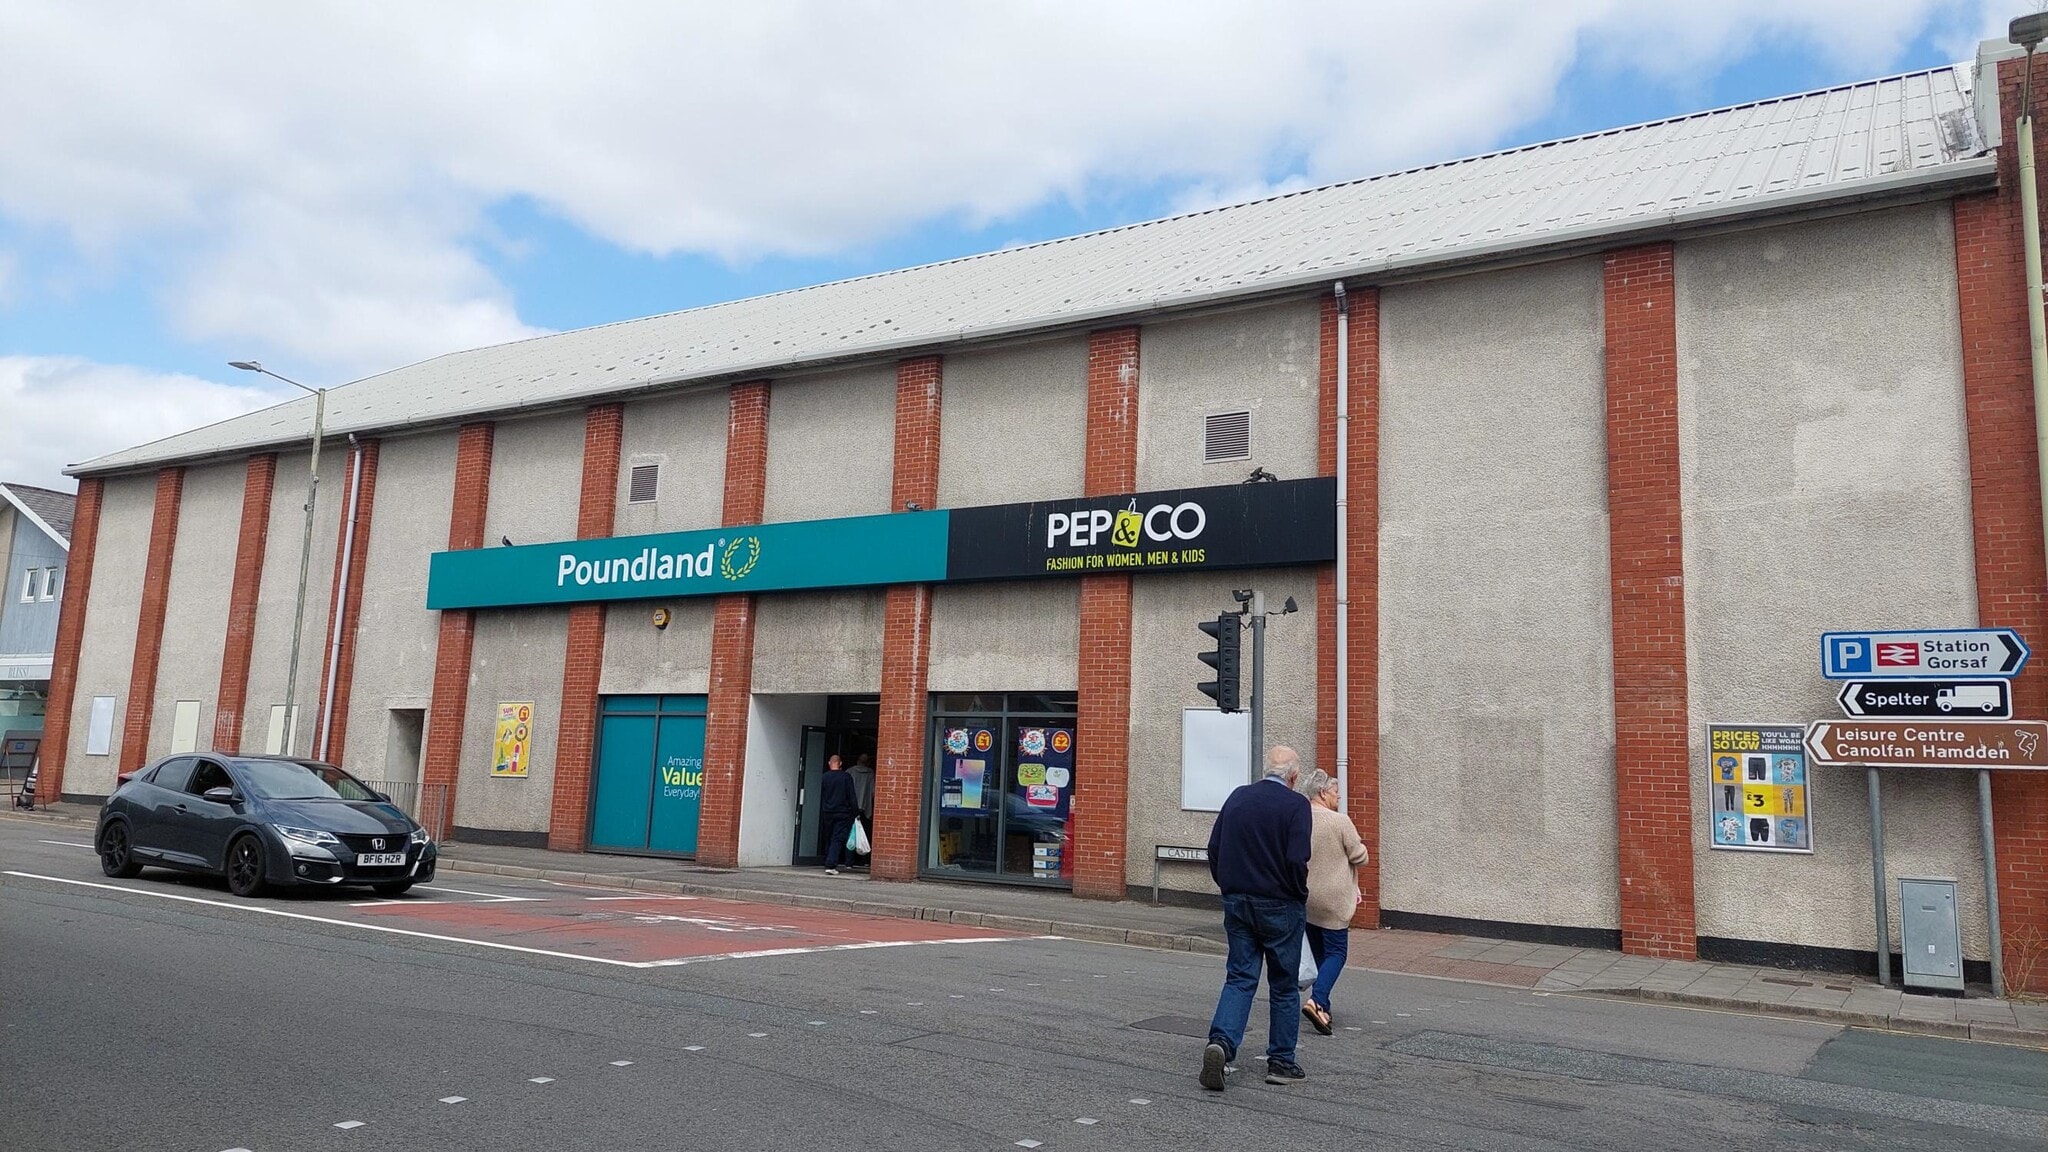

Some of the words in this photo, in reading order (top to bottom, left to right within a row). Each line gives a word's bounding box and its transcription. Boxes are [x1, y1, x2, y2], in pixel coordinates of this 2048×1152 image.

[1047, 502, 1206, 548] PEP&CO
[557, 543, 714, 586] Poundland
[1046, 556, 1084, 571] FASHION
[1086, 554, 1104, 568] FOR
[1106, 552, 1145, 567] WOMEN,
[1147, 551, 1169, 565] MEN
[1171, 552, 1179, 564] &
[1181, 549, 1205, 563] KIDS
[1923, 640, 1990, 653] Station
[1838, 641, 1862, 669] P
[1927, 655, 1988, 669] Gorsaf
[1865, 692, 1930, 708] Spelter
[977, 735, 990, 746] £1
[1054, 736, 1068, 747] £2
[1713, 730, 1760, 741] PRICES
[1761, 731, 1789, 739] YOU'LL
[1836, 727, 1898, 741] Leisure
[1903, 728, 1966, 742] Centre
[1713, 740, 1730, 750] SO
[1733, 741, 1760, 750] LOW
[1836, 743, 1915, 758] Canolfan
[1922, 744, 2010, 759] Hamdden
[667, 756, 702, 769] Amazing
[662, 766, 703, 787] Value
[663, 786, 700, 800] Everyday!
[1746, 793, 1765, 807] £3
[363, 854, 383, 863] BF16
[385, 854, 401, 863] HZR
[1167, 848, 1201, 859] CASTLE
